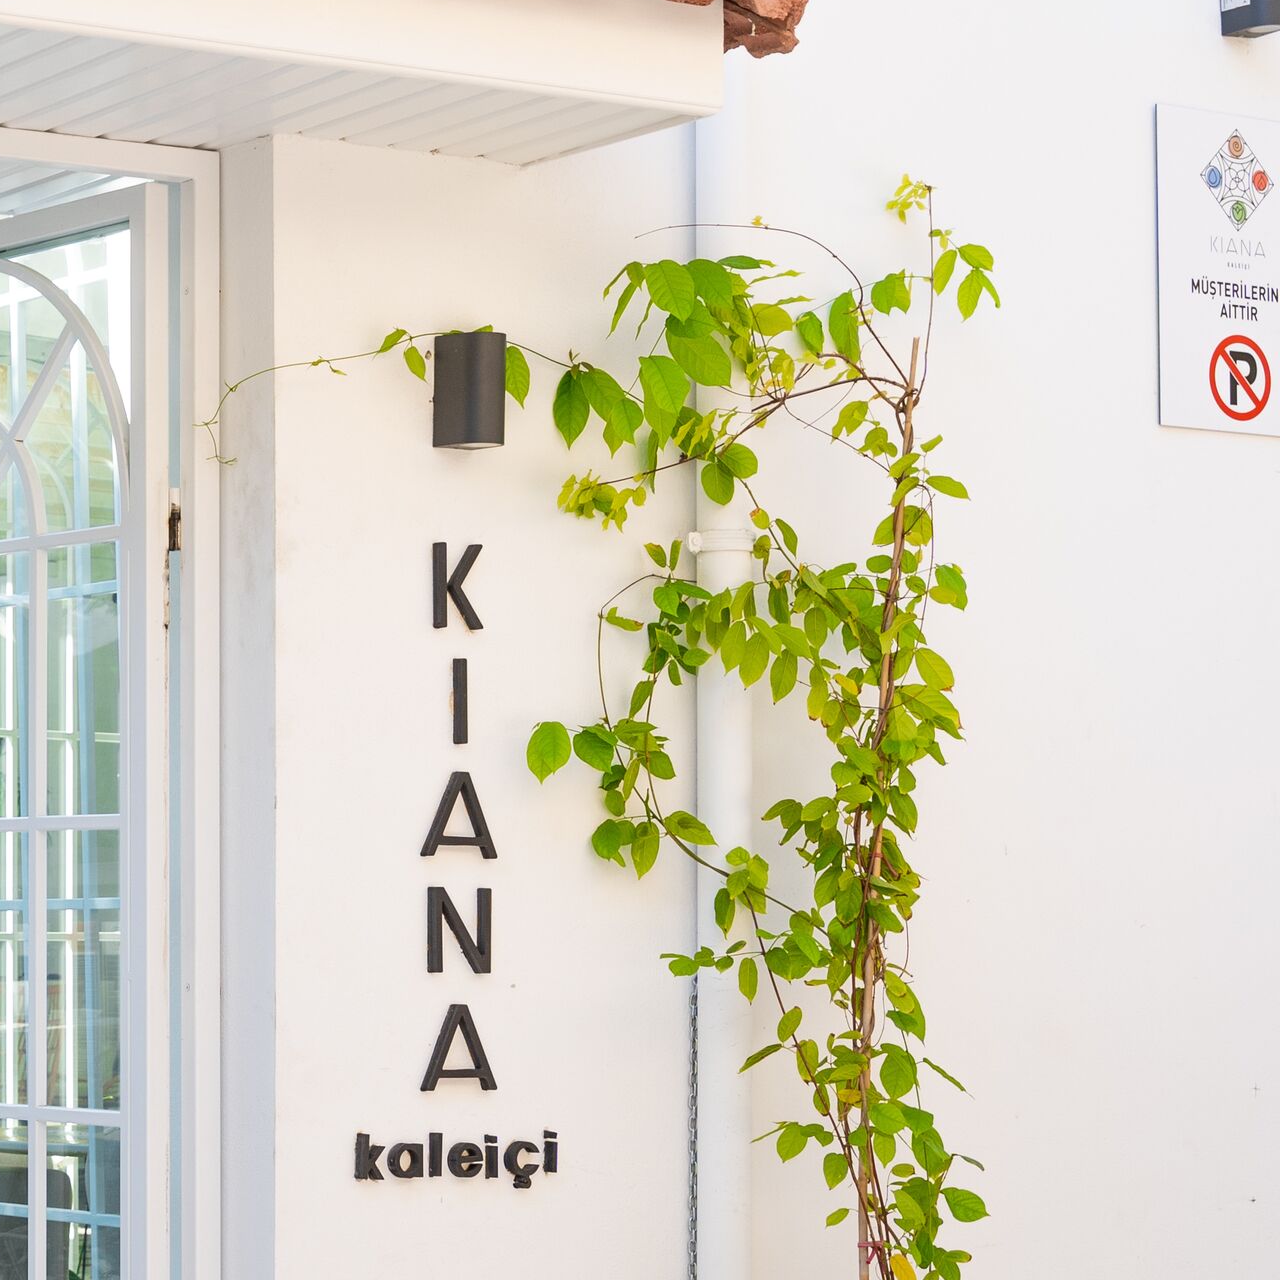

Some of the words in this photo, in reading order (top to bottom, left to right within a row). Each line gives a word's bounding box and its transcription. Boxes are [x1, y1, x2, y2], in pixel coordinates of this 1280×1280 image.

[1210, 235, 1266, 258] KIANA
[1220, 300, 1259, 321] AİTTİR
[1229, 350, 1258, 406] P
[418, 541, 498, 1092] KIANA
[354, 1130, 558, 1189] kaleiçi
